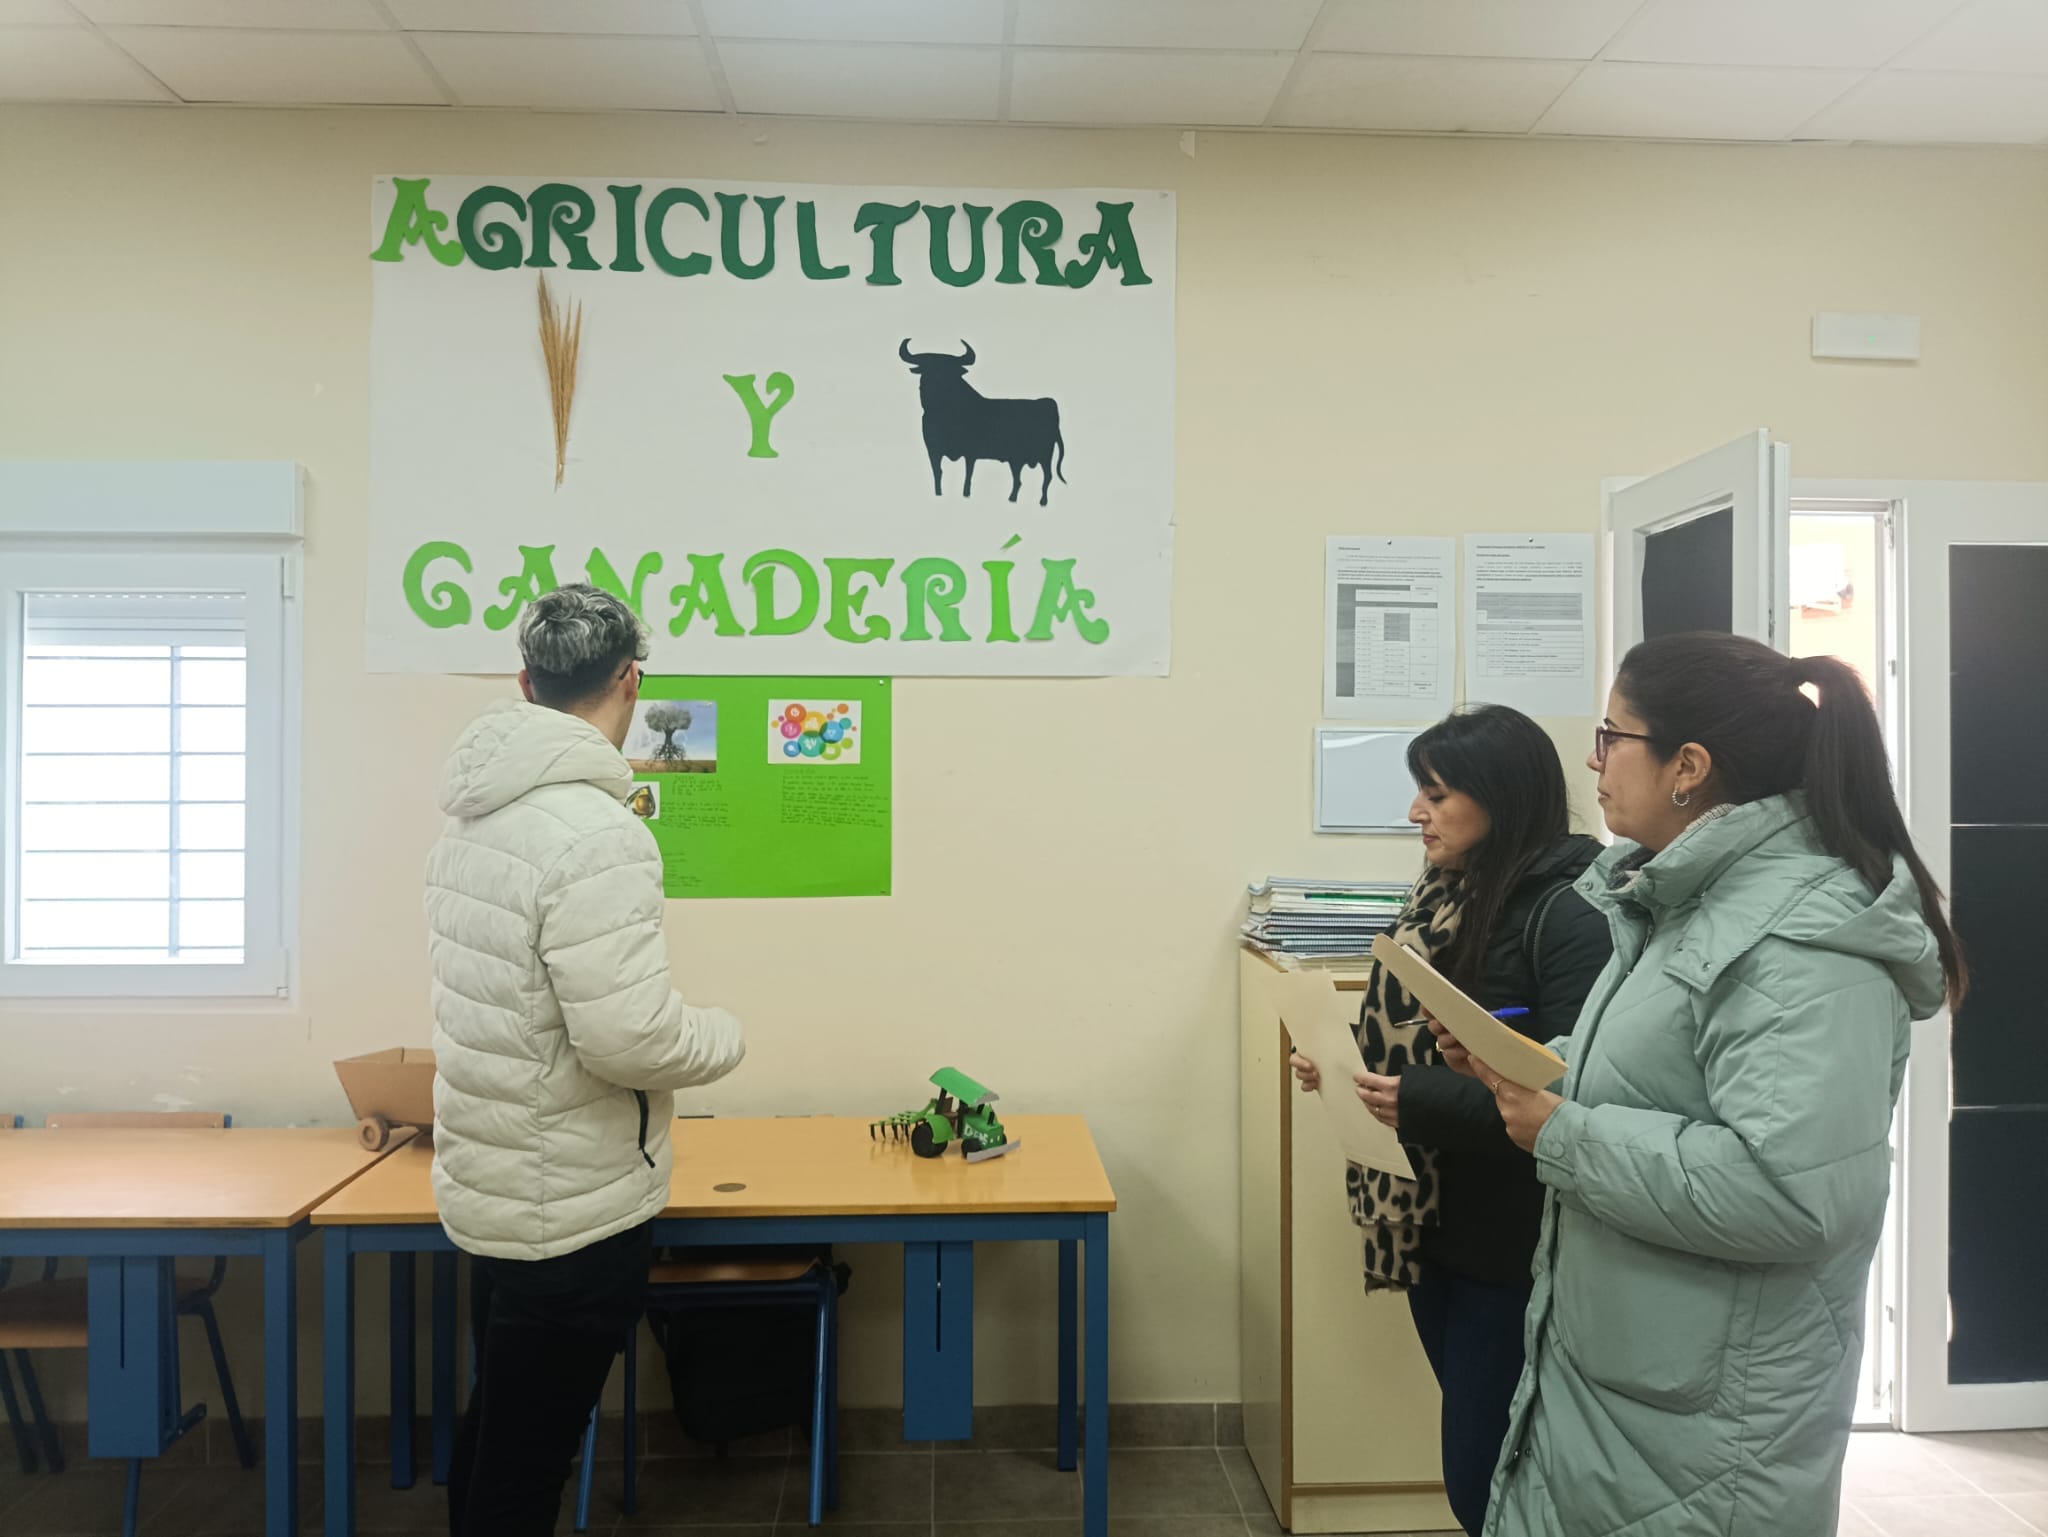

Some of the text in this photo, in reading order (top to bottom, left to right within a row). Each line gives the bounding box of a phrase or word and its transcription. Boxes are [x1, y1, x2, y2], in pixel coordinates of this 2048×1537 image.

[370, 178, 1152, 288] AGRICULTURA
[723, 371, 794, 458] Y
[403, 534, 1109, 643] GANADERÍA
